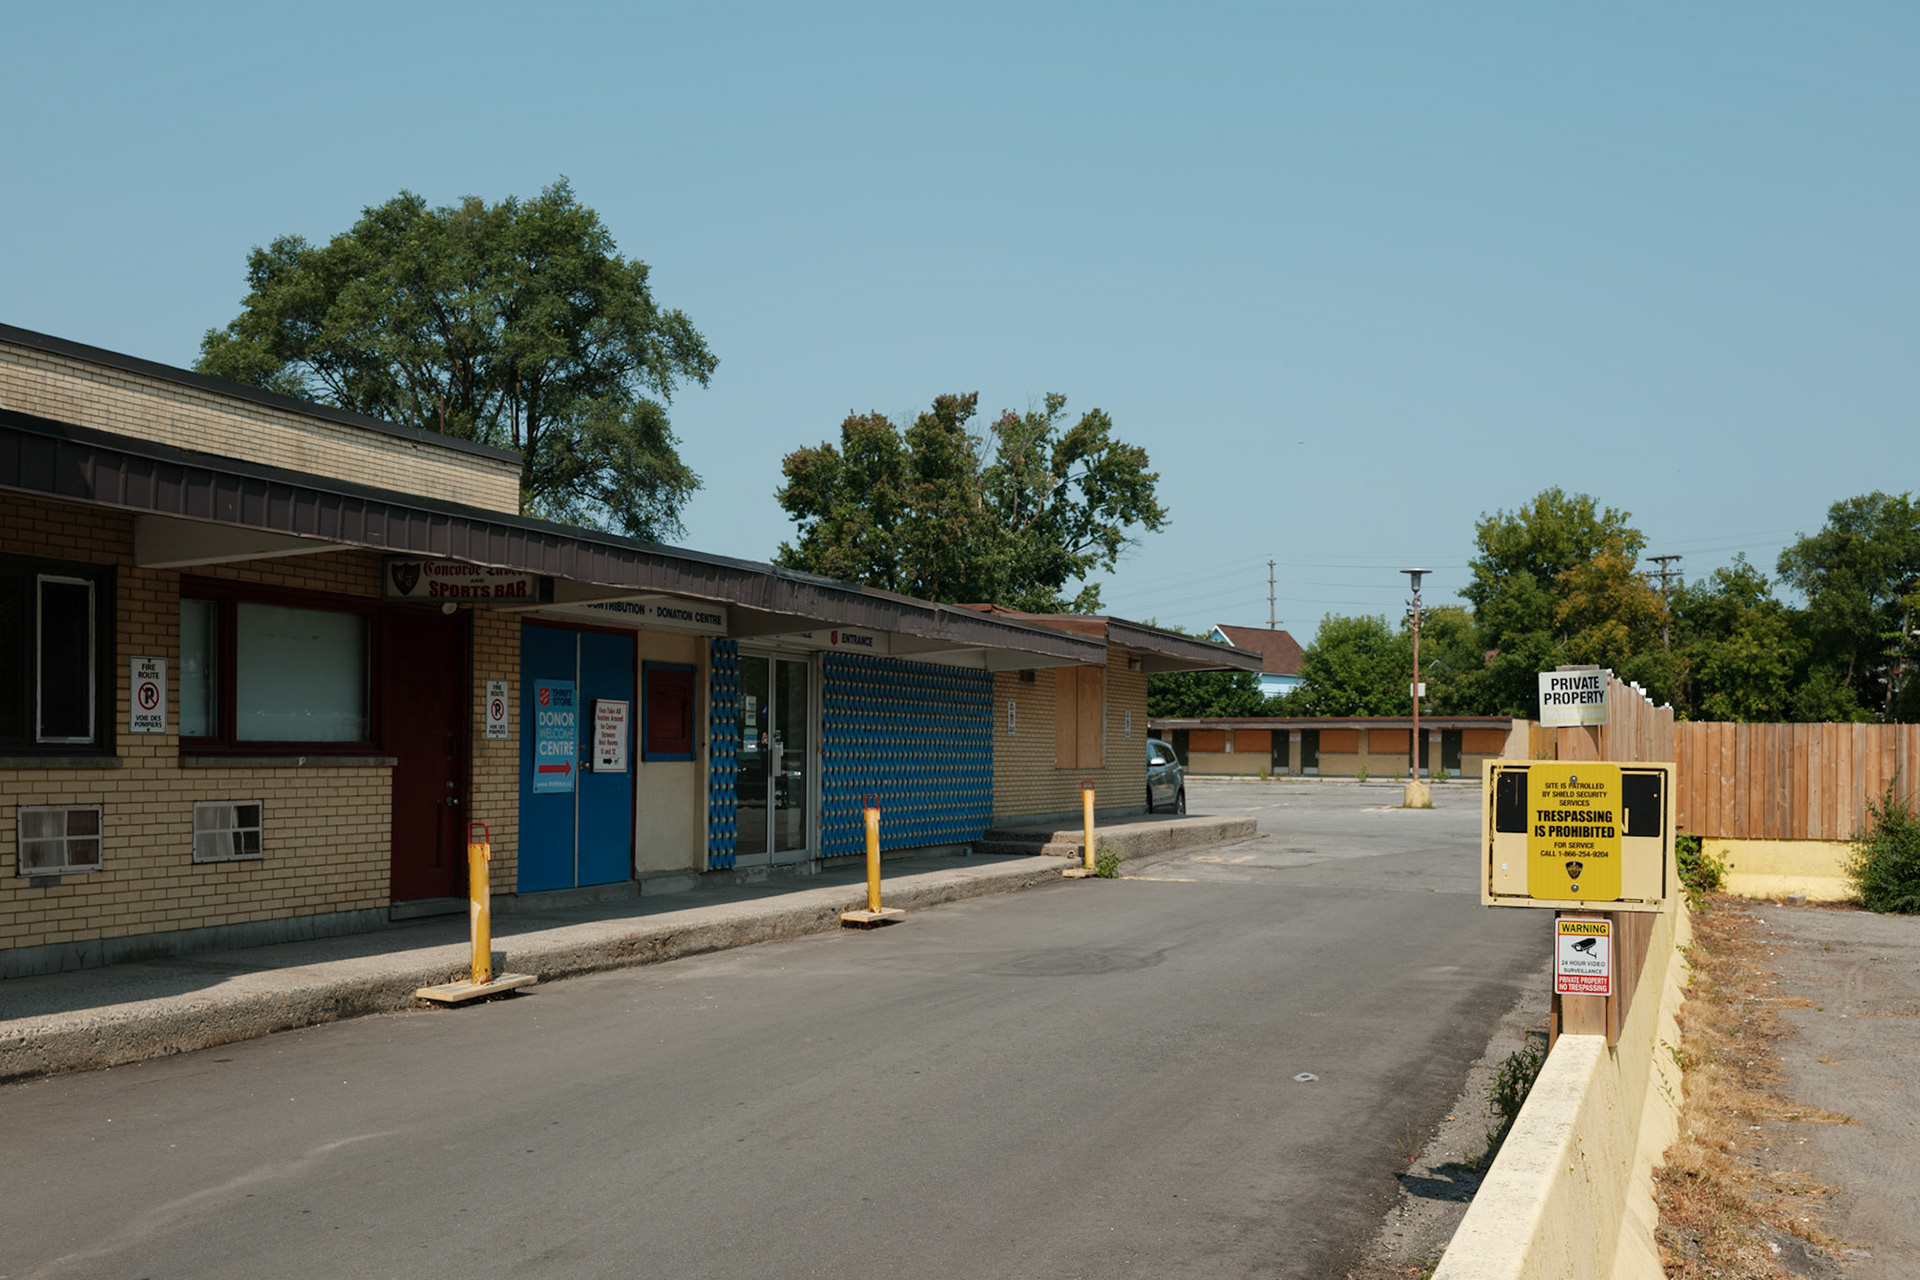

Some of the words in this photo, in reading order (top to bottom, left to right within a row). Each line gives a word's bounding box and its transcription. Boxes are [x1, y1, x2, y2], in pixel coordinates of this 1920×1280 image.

[423, 561, 481, 576] Concorde
[429, 580, 490, 597] SPORTS
[495, 580, 527, 597] BAR
[657, 607, 693, 621] DONATION
[695, 612, 722, 625] CENTRE
[842, 633, 873, 647] ENTRANCE
[138, 671, 159, 679] ROUTE
[1551, 676, 1599, 690] PRIVATE
[552, 688, 572, 697] THRIFT
[1544, 690, 1604, 705] PROPERTY
[553, 697, 572, 706] STORE
[539, 711, 574, 726] DONOR
[539, 727, 574, 739] WELCOME
[539, 741, 574, 756] CENTRE
[1536, 810, 1613, 822] TRESPASSING
[1535, 825, 1545, 837] IS
[1548, 825, 1615, 838] PROHIBITED
[1562, 924, 1606, 933] WARNING
[1568, 983, 1607, 992] TRESPASSING
